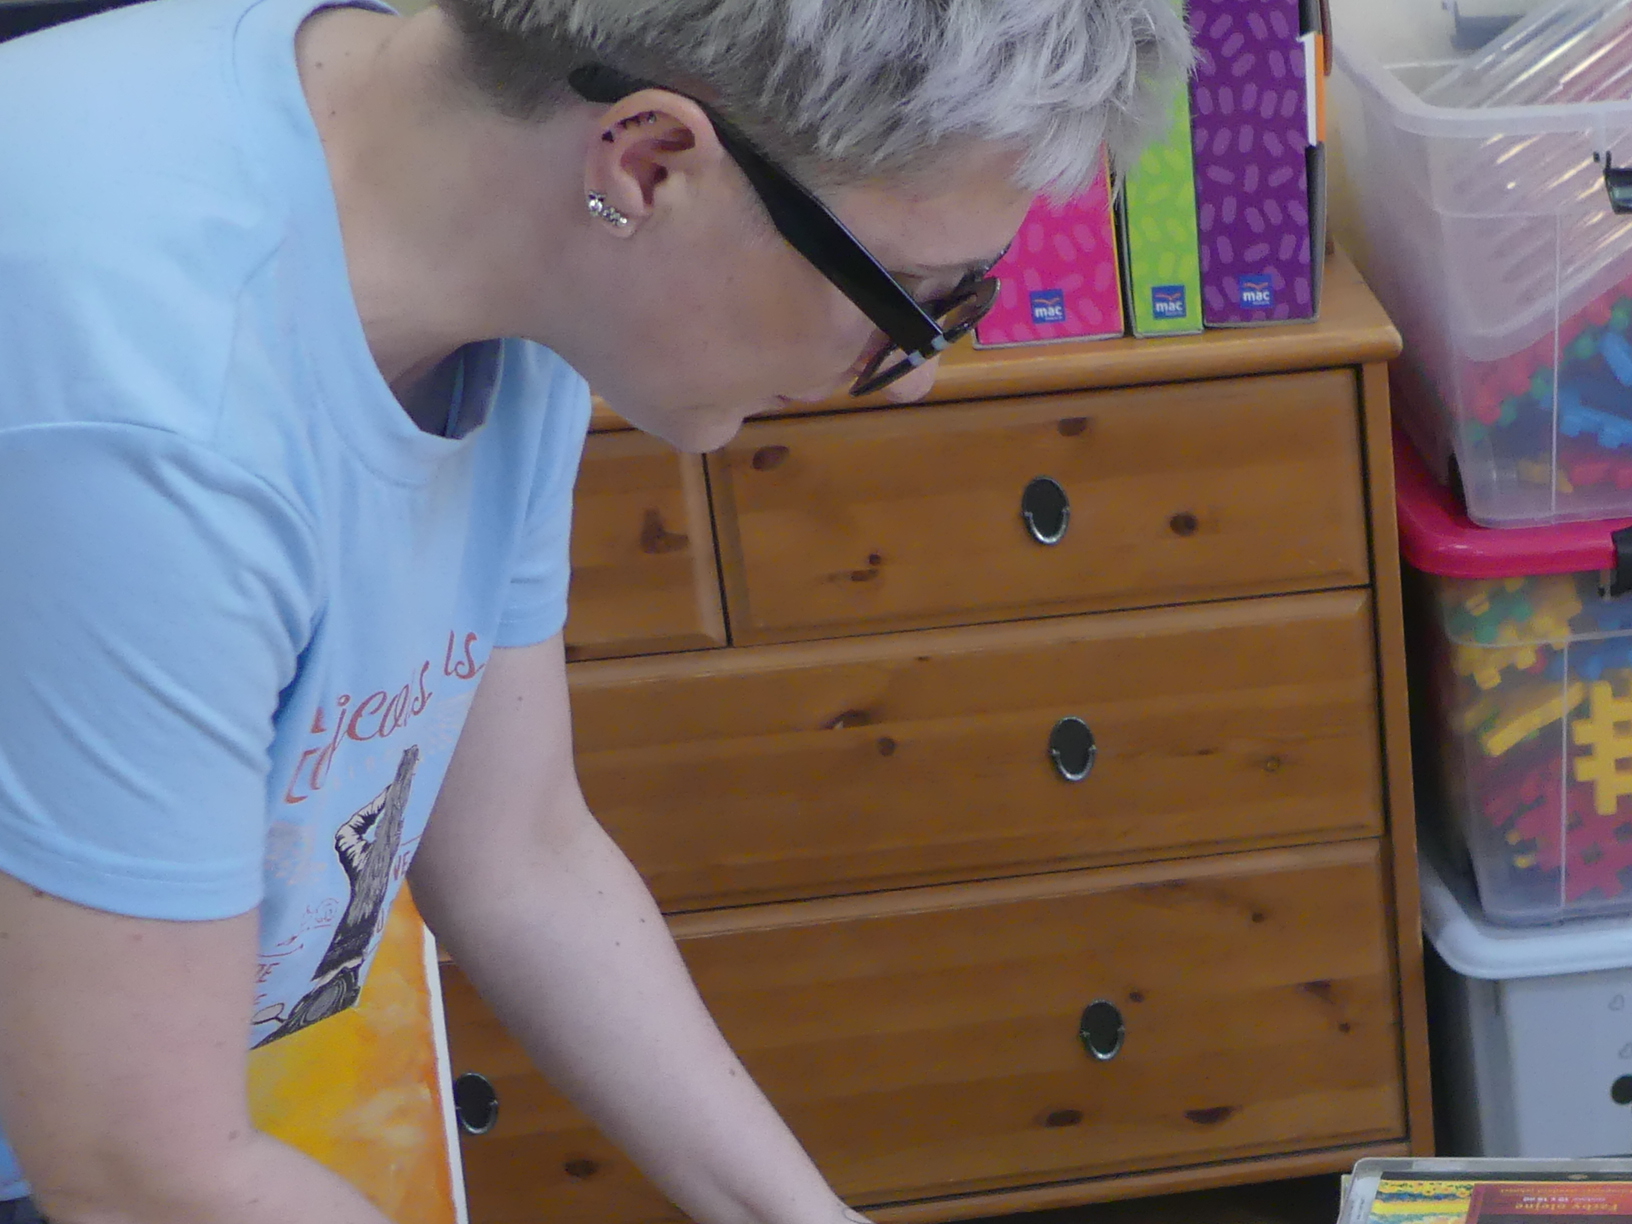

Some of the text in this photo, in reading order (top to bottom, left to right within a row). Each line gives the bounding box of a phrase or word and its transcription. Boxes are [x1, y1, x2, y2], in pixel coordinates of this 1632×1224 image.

[1243, 290, 1270, 302] mac
[1034, 306, 1063, 318] mac
[1155, 301, 1183, 312] mac
